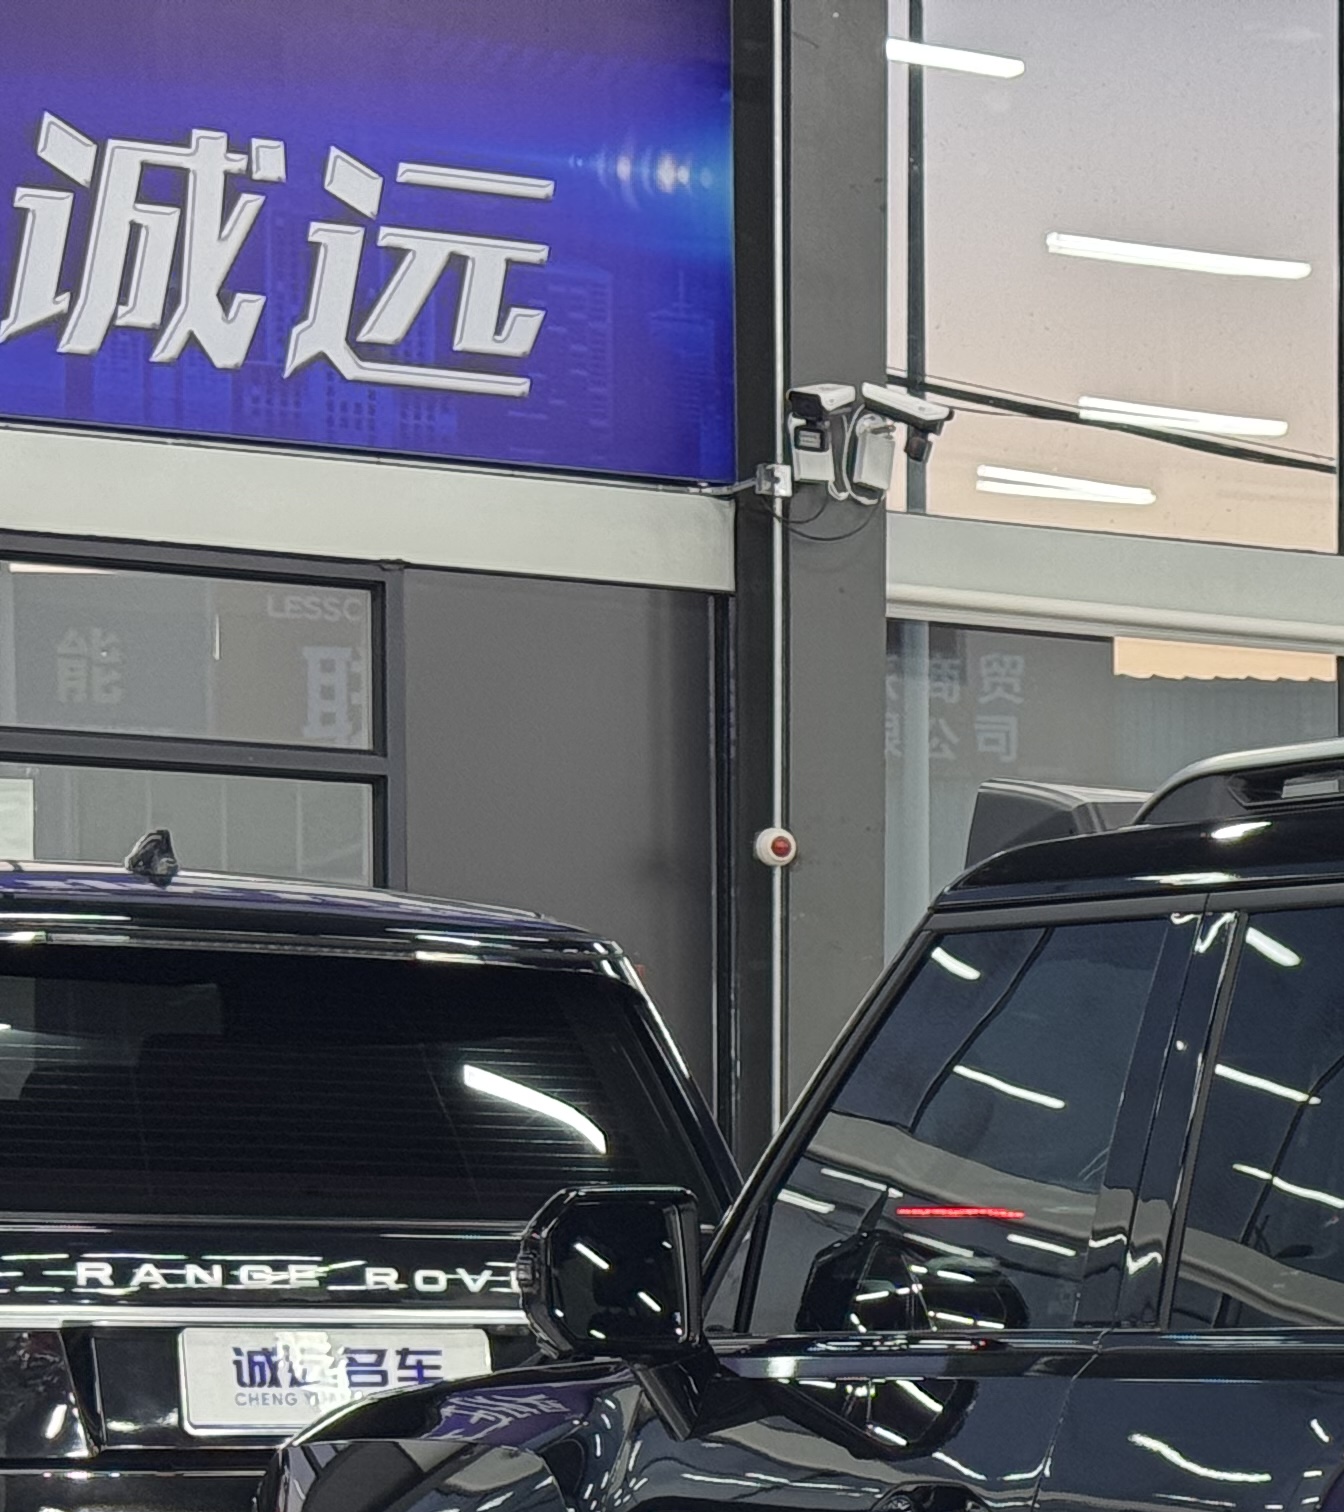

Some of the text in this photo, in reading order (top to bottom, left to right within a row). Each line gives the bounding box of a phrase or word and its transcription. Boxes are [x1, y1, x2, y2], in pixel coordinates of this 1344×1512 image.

[0, 111, 555, 397] 诚远
[76, 1260, 322, 1289] RANGE
[234, 1391, 298, 1407] CHENG
